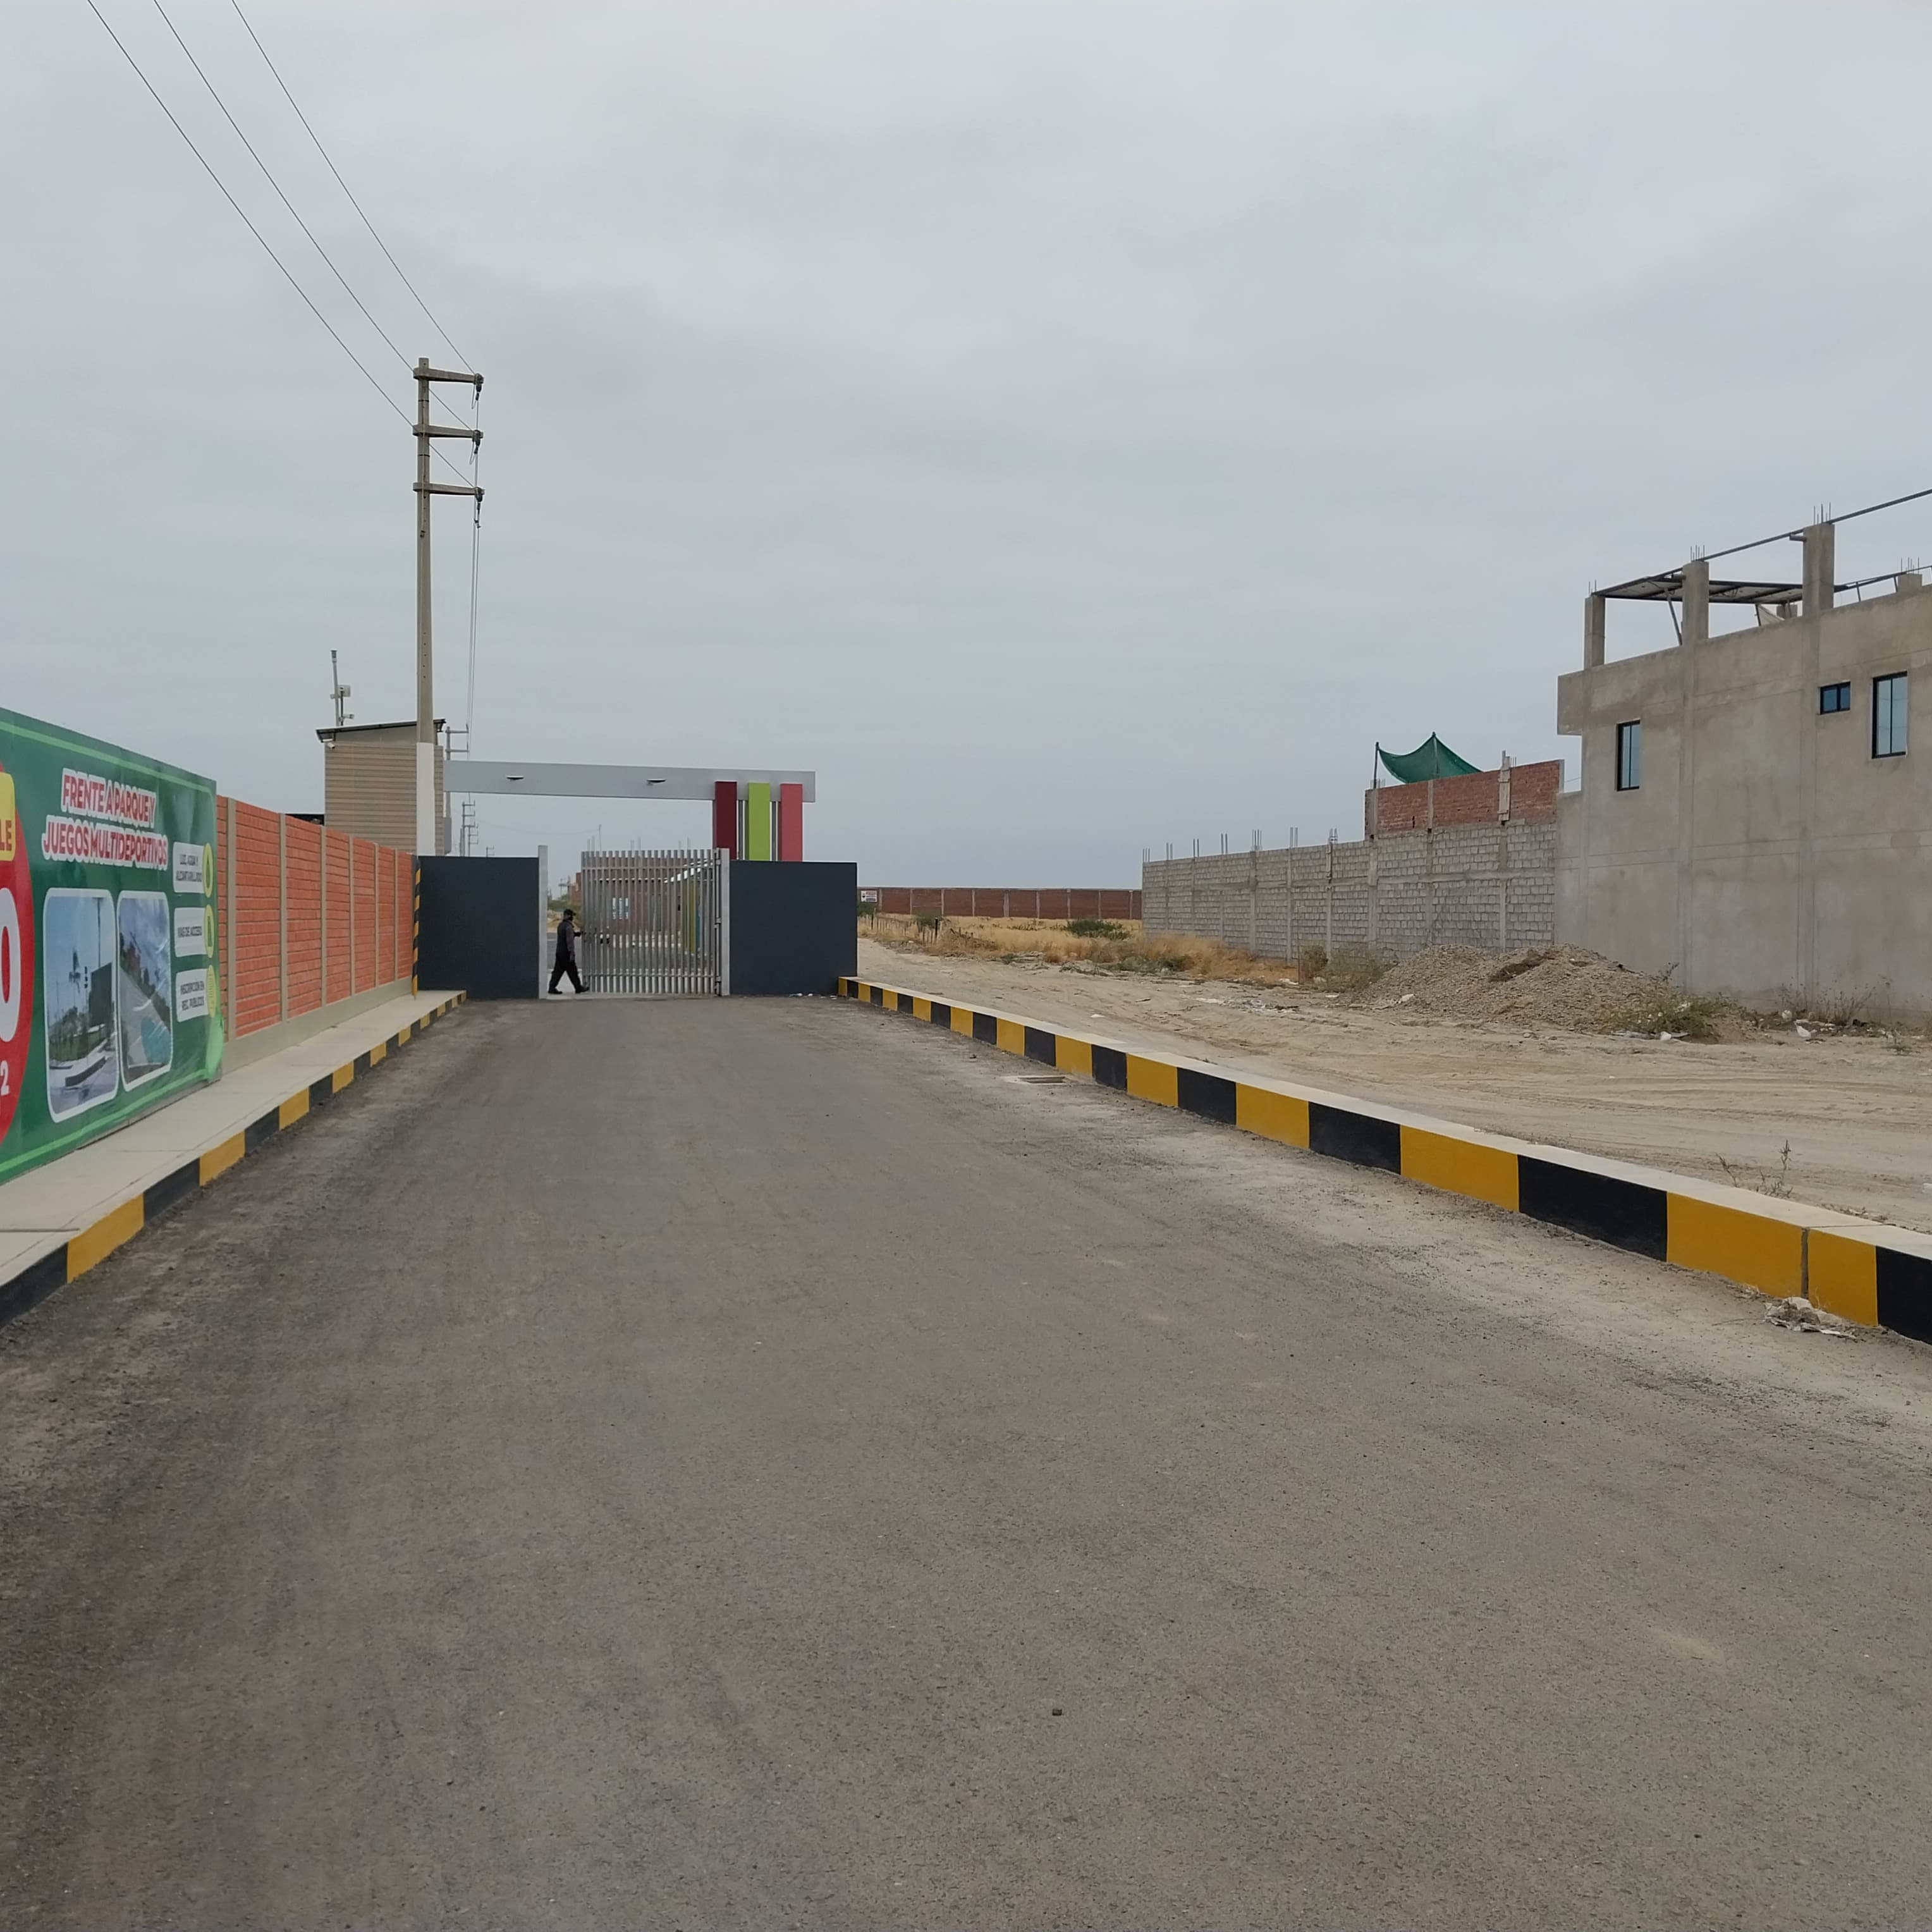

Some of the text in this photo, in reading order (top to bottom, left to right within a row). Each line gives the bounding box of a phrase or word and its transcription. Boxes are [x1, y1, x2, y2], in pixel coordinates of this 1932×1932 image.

[63, 774, 156, 824] FRENTE A PARQUE Y
[43, 821, 168, 865] JUEGOS MULTIDEPORTIVOS
